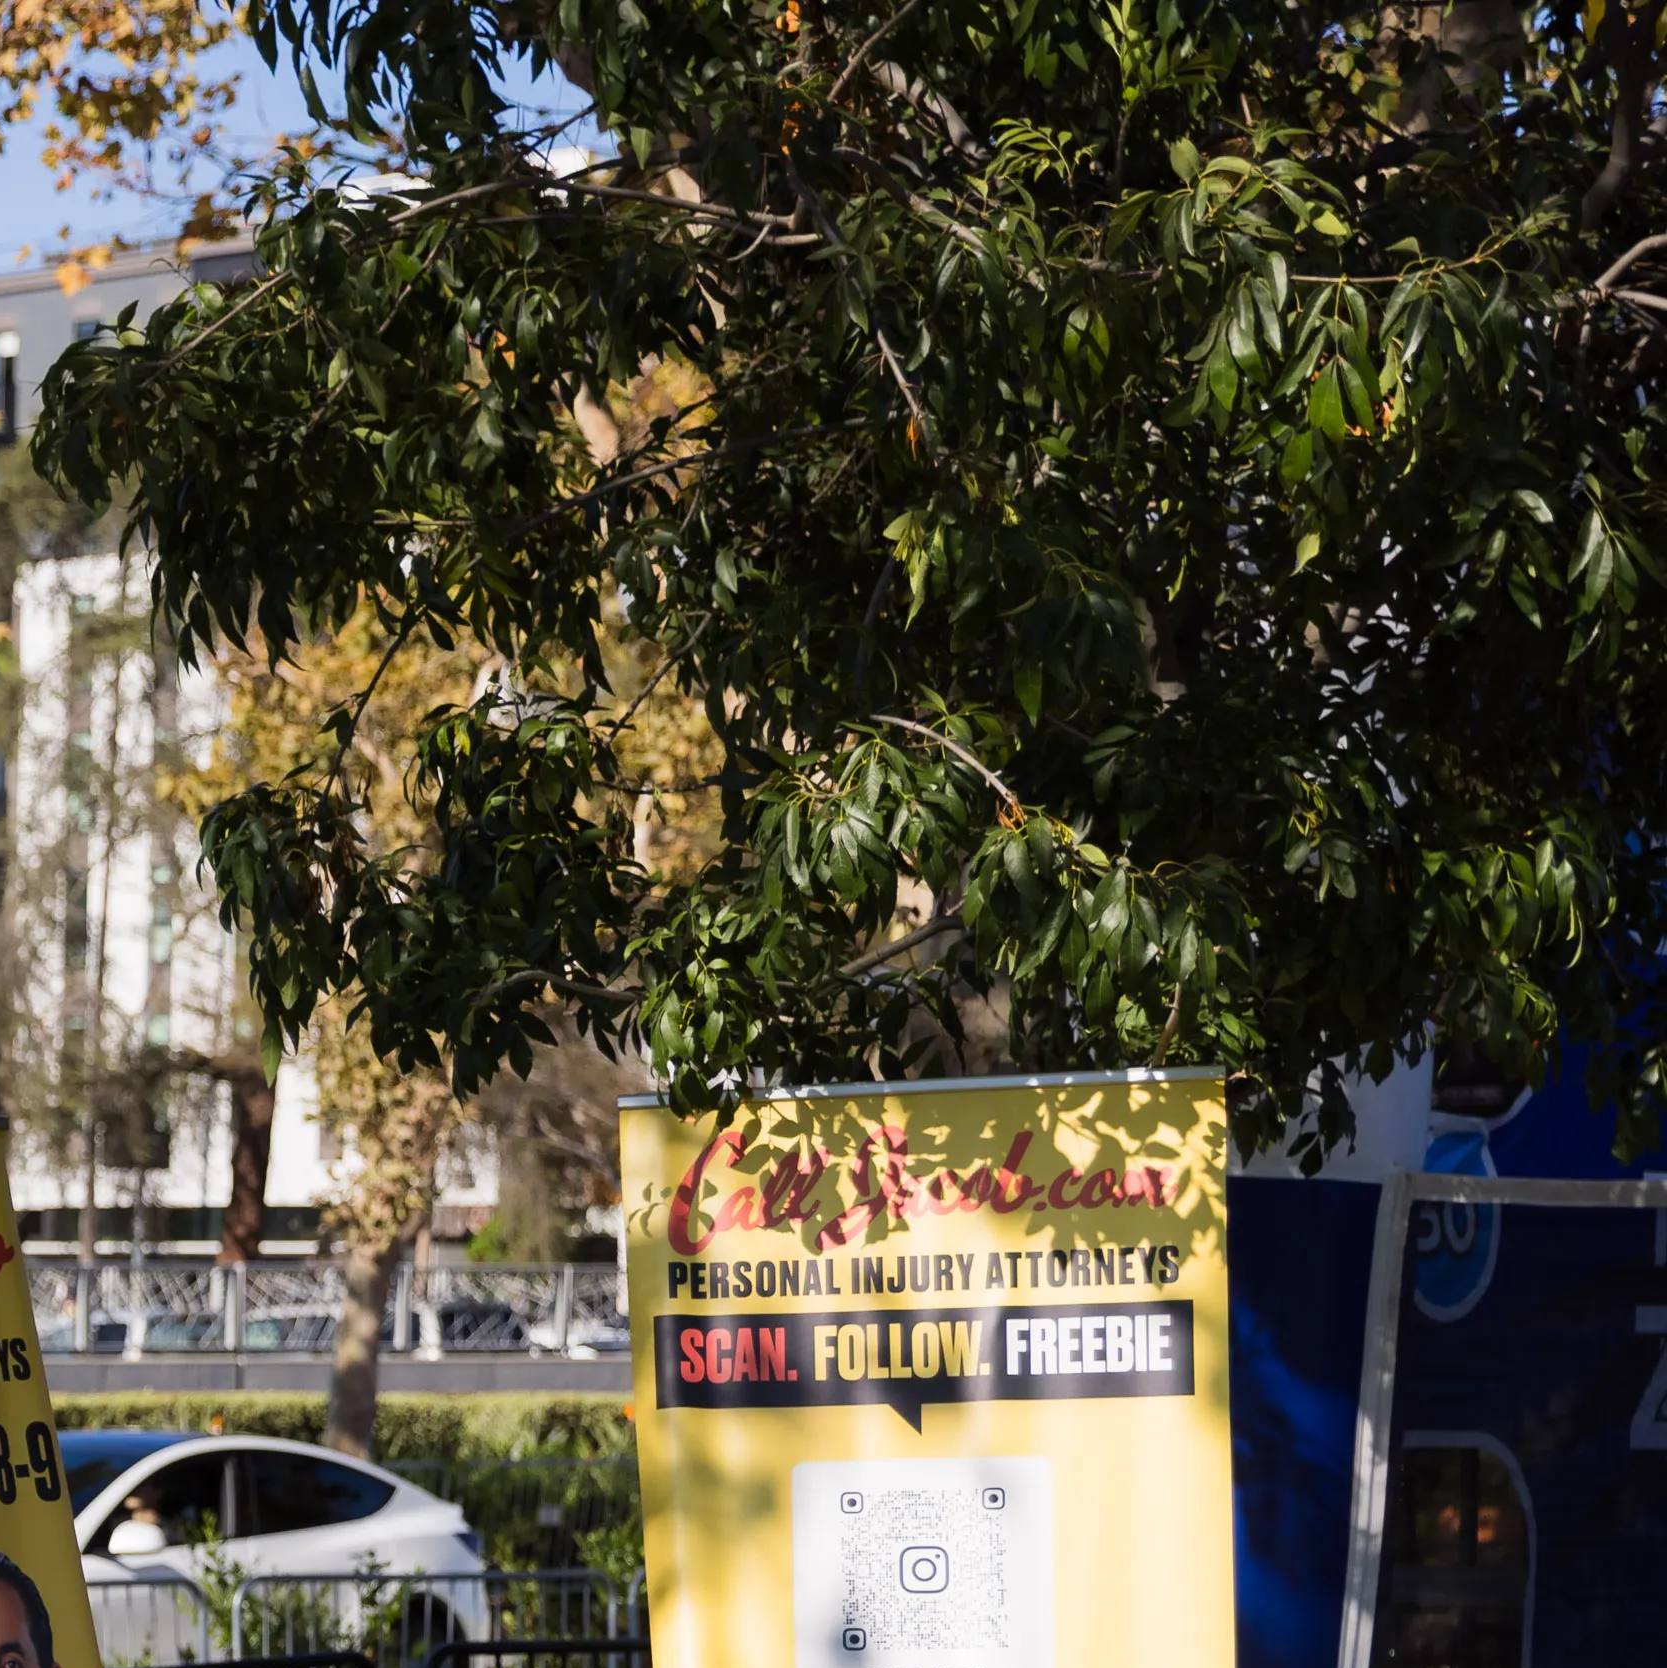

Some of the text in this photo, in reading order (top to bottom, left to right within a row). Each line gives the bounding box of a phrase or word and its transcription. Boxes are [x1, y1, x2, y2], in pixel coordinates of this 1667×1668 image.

[667, 1130, 831, 1256] Call
[667, 1246, 1180, 1299] PERSONAL INJURY ATTORNEYS
[679, 1313, 1174, 1384] SCAN. FOLLOW. FREEBIE
